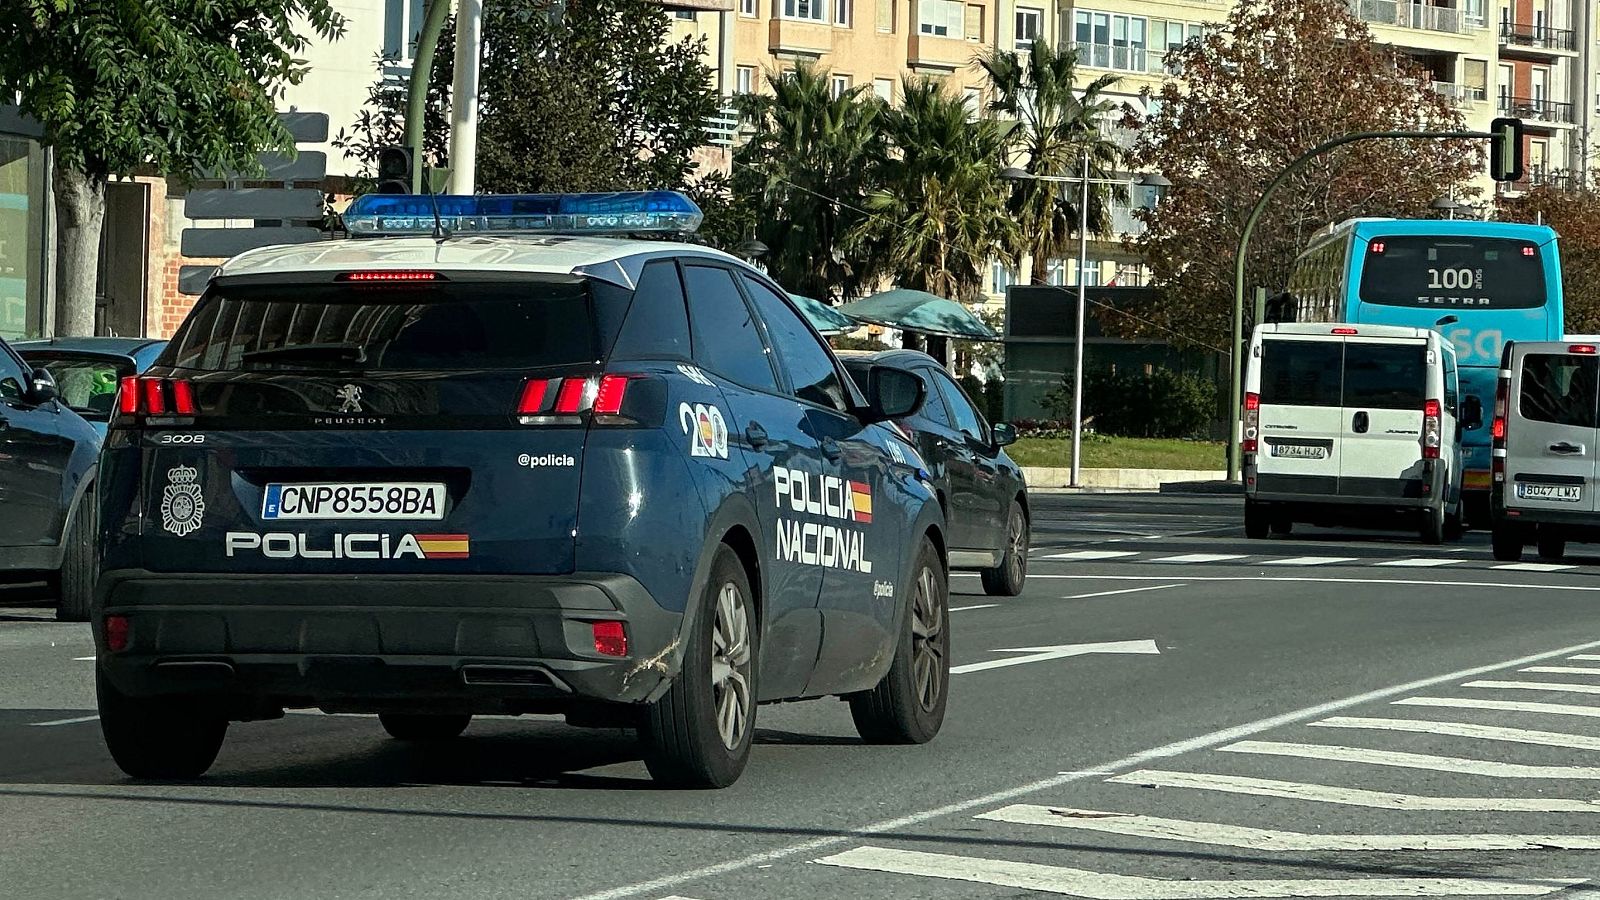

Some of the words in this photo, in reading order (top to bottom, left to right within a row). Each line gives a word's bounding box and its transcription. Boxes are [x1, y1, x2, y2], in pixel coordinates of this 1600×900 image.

[1428, 268, 1473, 289] 100
[1417, 296, 1490, 305] SETRA
[314, 417, 386, 425] PEUGEOT
[161, 434, 205, 444] 3008
[679, 402, 728, 459] 200
[1527, 485, 1554, 496] 8047
[1557, 486, 1578, 498] LMX
[268, 504, 276, 513] E
[280, 487, 436, 515] CNP8558BA
[776, 517, 873, 574] NACIONAL
